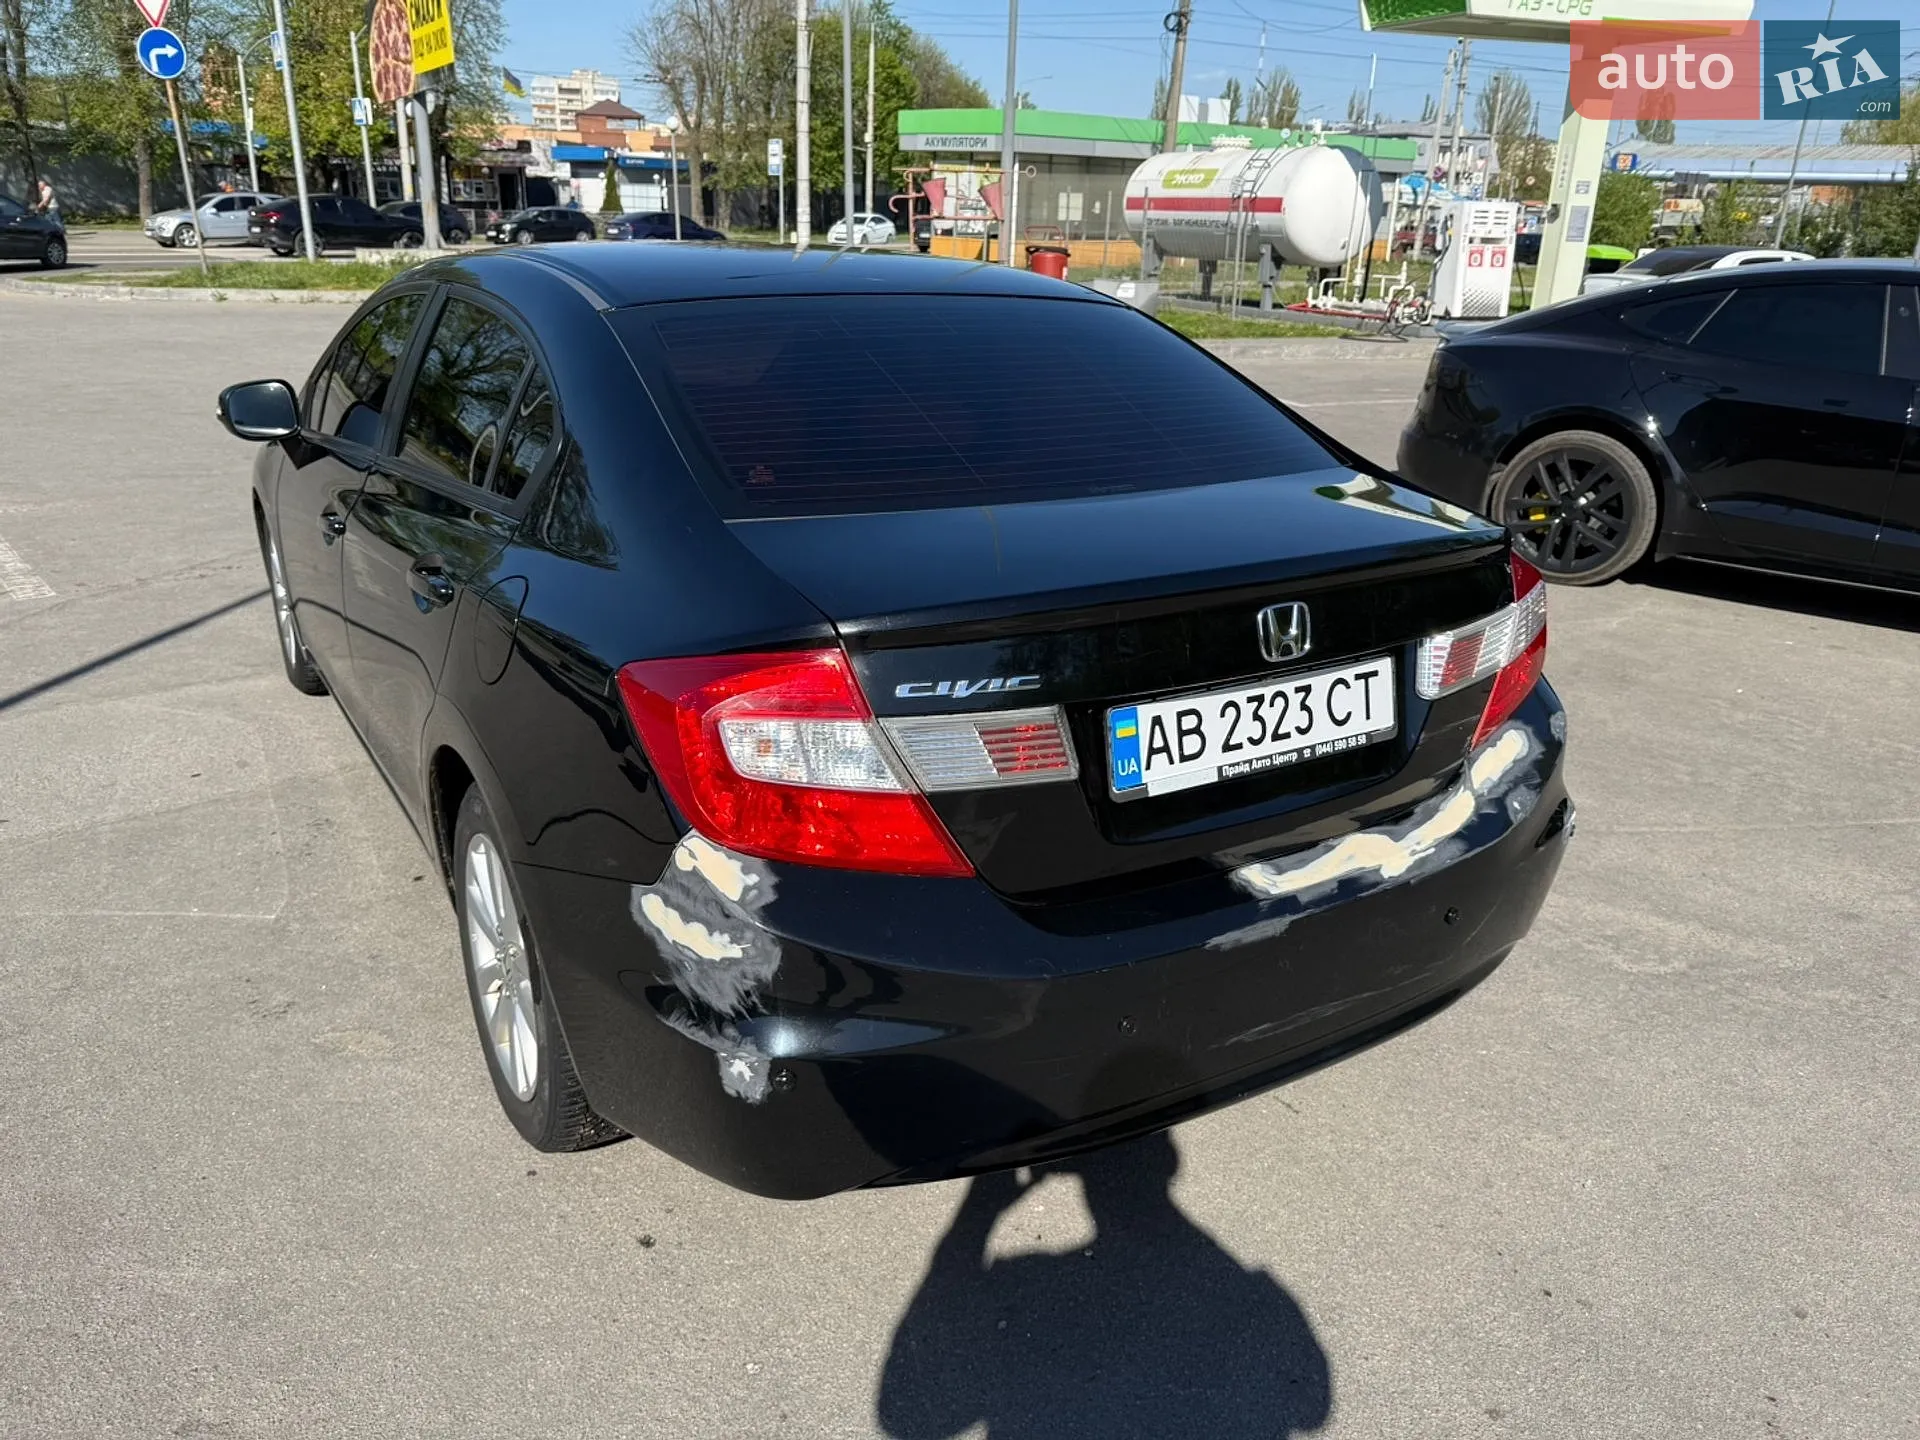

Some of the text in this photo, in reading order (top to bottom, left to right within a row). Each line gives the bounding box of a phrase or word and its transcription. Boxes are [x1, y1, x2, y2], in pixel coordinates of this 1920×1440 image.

[924, 136, 988, 148] АКУМУЛЯТОРИ
[895, 675, 1041, 698] CIVIC
[1220, 684, 1313, 753] 2323
[1118, 757, 1139, 776] UA
[1222, 761, 1250, 777] Прайд
[1251, 758, 1271, 769] Авто
[1272, 752, 1298, 765] Центр
